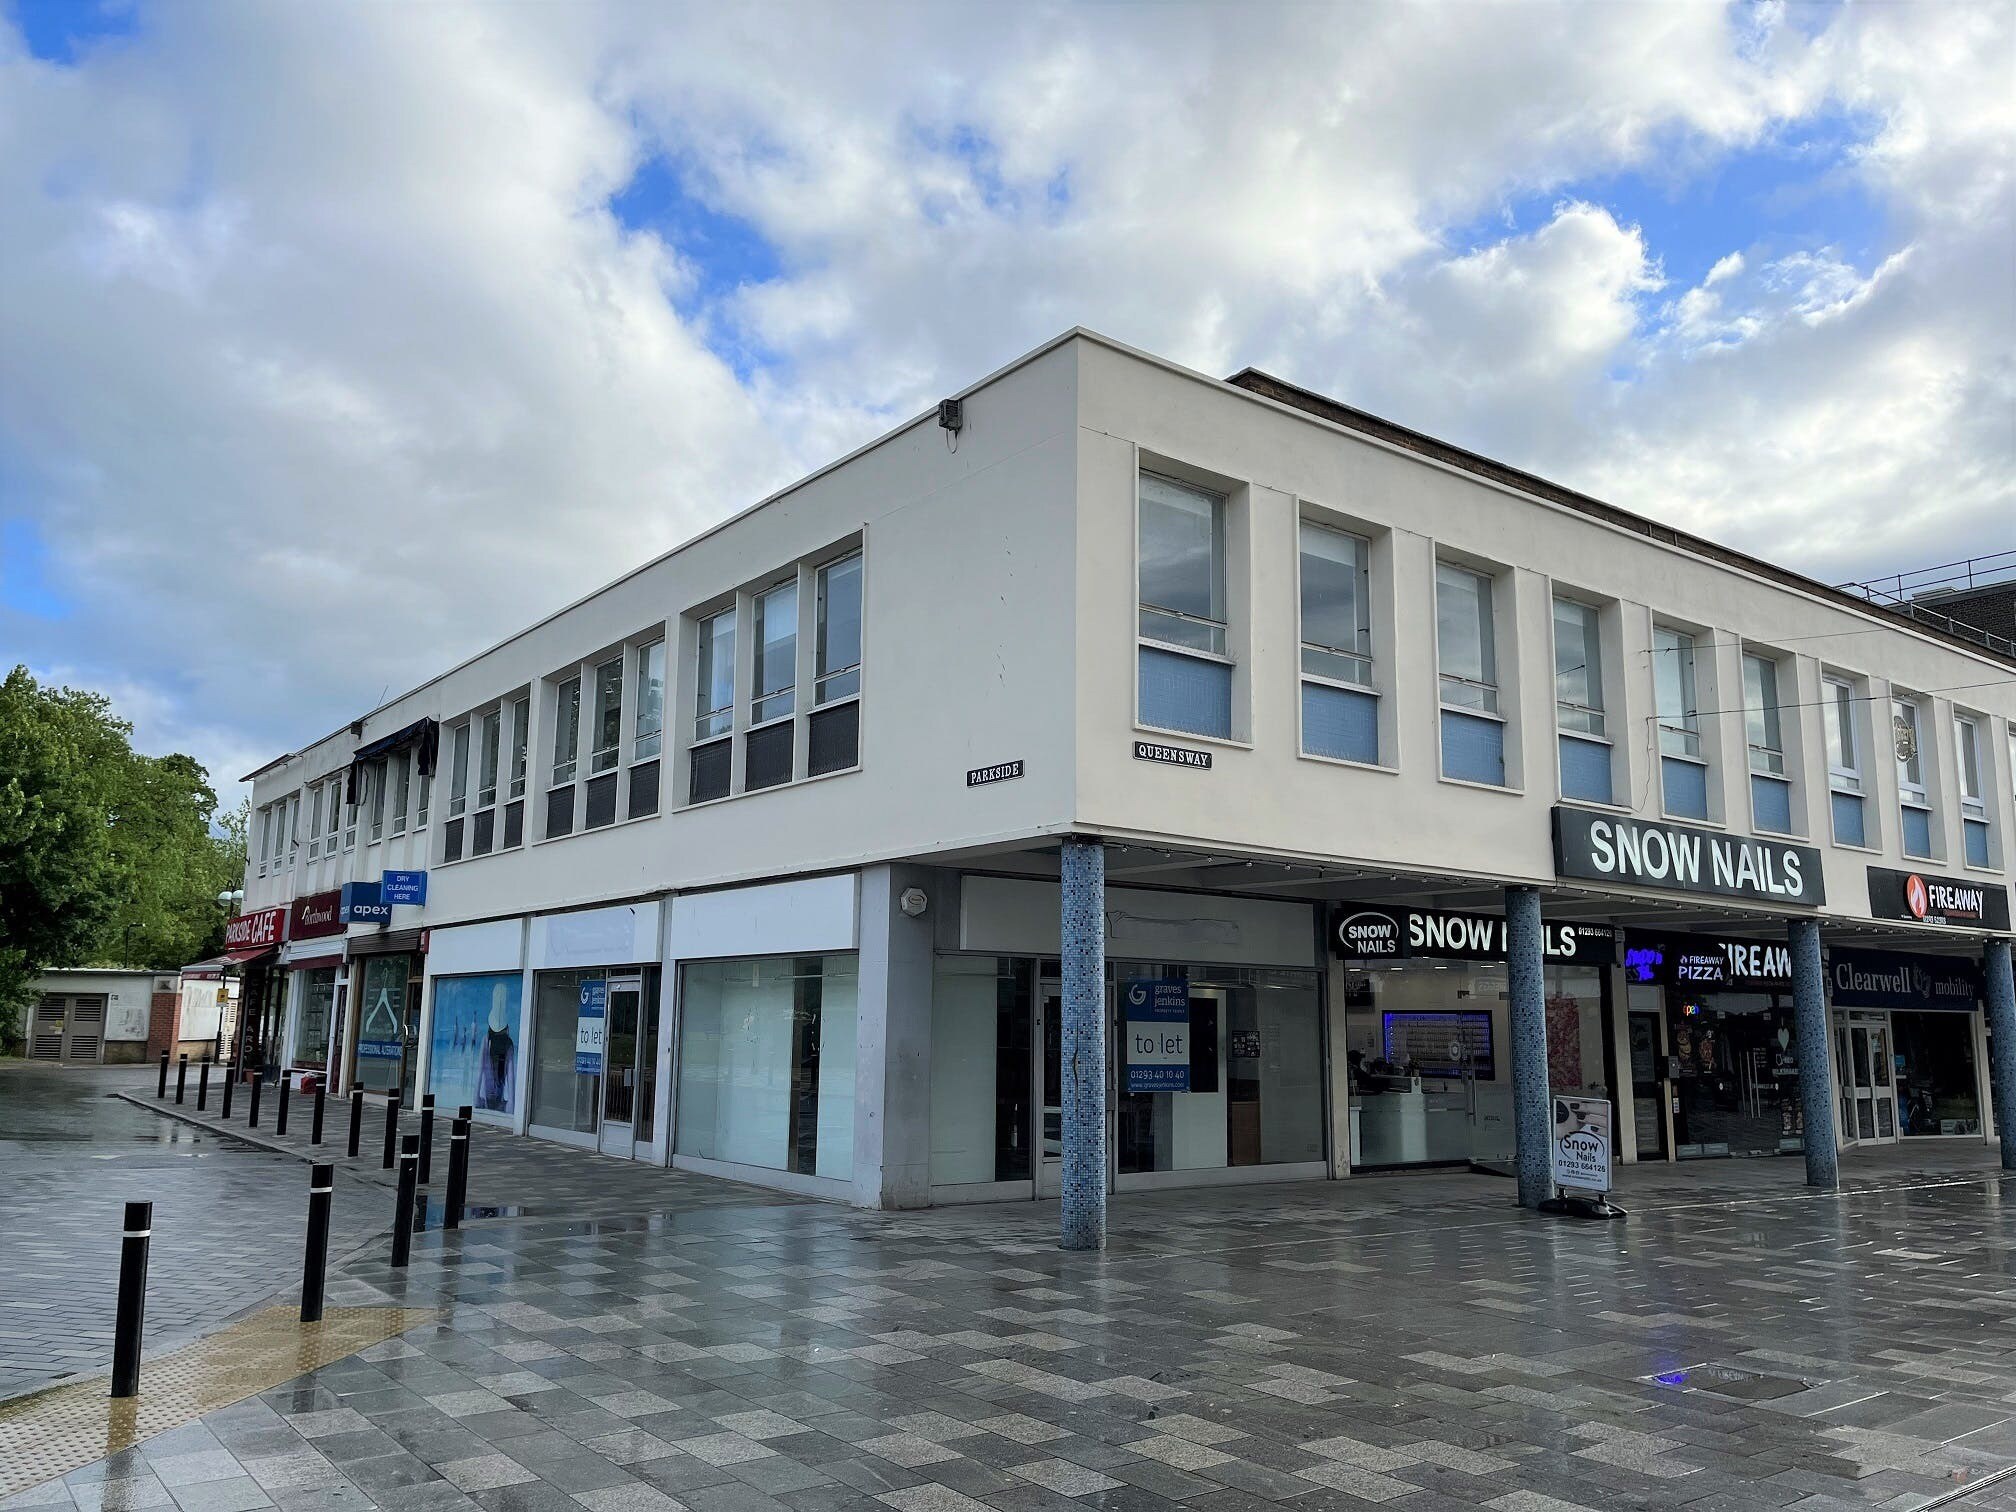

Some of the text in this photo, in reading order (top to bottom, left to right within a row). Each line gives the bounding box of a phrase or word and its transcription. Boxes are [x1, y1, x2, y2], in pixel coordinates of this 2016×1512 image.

[1138, 745, 1208, 766] QUEENSWAY
[971, 763, 1019, 784] PARKSIDE
[1590, 820, 1804, 897] SNOW NAILS
[387, 884, 419, 892] CLEANING
[1928, 884, 1984, 919] FIREAWAY
[353, 905, 389, 917] apex
[226, 911, 277, 944] PARKSIDE CAFE
[1348, 924, 1392, 939] SNOW
[1409, 913, 1494, 952] SNOW
[1357, 940, 1396, 954] NAILS
[1689, 955, 1724, 965] FIREAWAY
[1718, 943, 1792, 978] IREAW
[1678, 966, 1724, 981] PIZZA
[1836, 963, 1975, 1000] Clearwell mobility
[1154, 985, 1182, 995] graves
[1154, 996, 1186, 1007] jenkins
[580, 1026, 603, 1045] to let
[1135, 1033, 1183, 1054] to let
[1130, 1070, 1185, 1080] 01293 40 10 40
[1564, 1134, 1599, 1153] Snow
[1558, 1160, 1580, 1169] 01293
[1576, 1151, 1597, 1163] Nails
